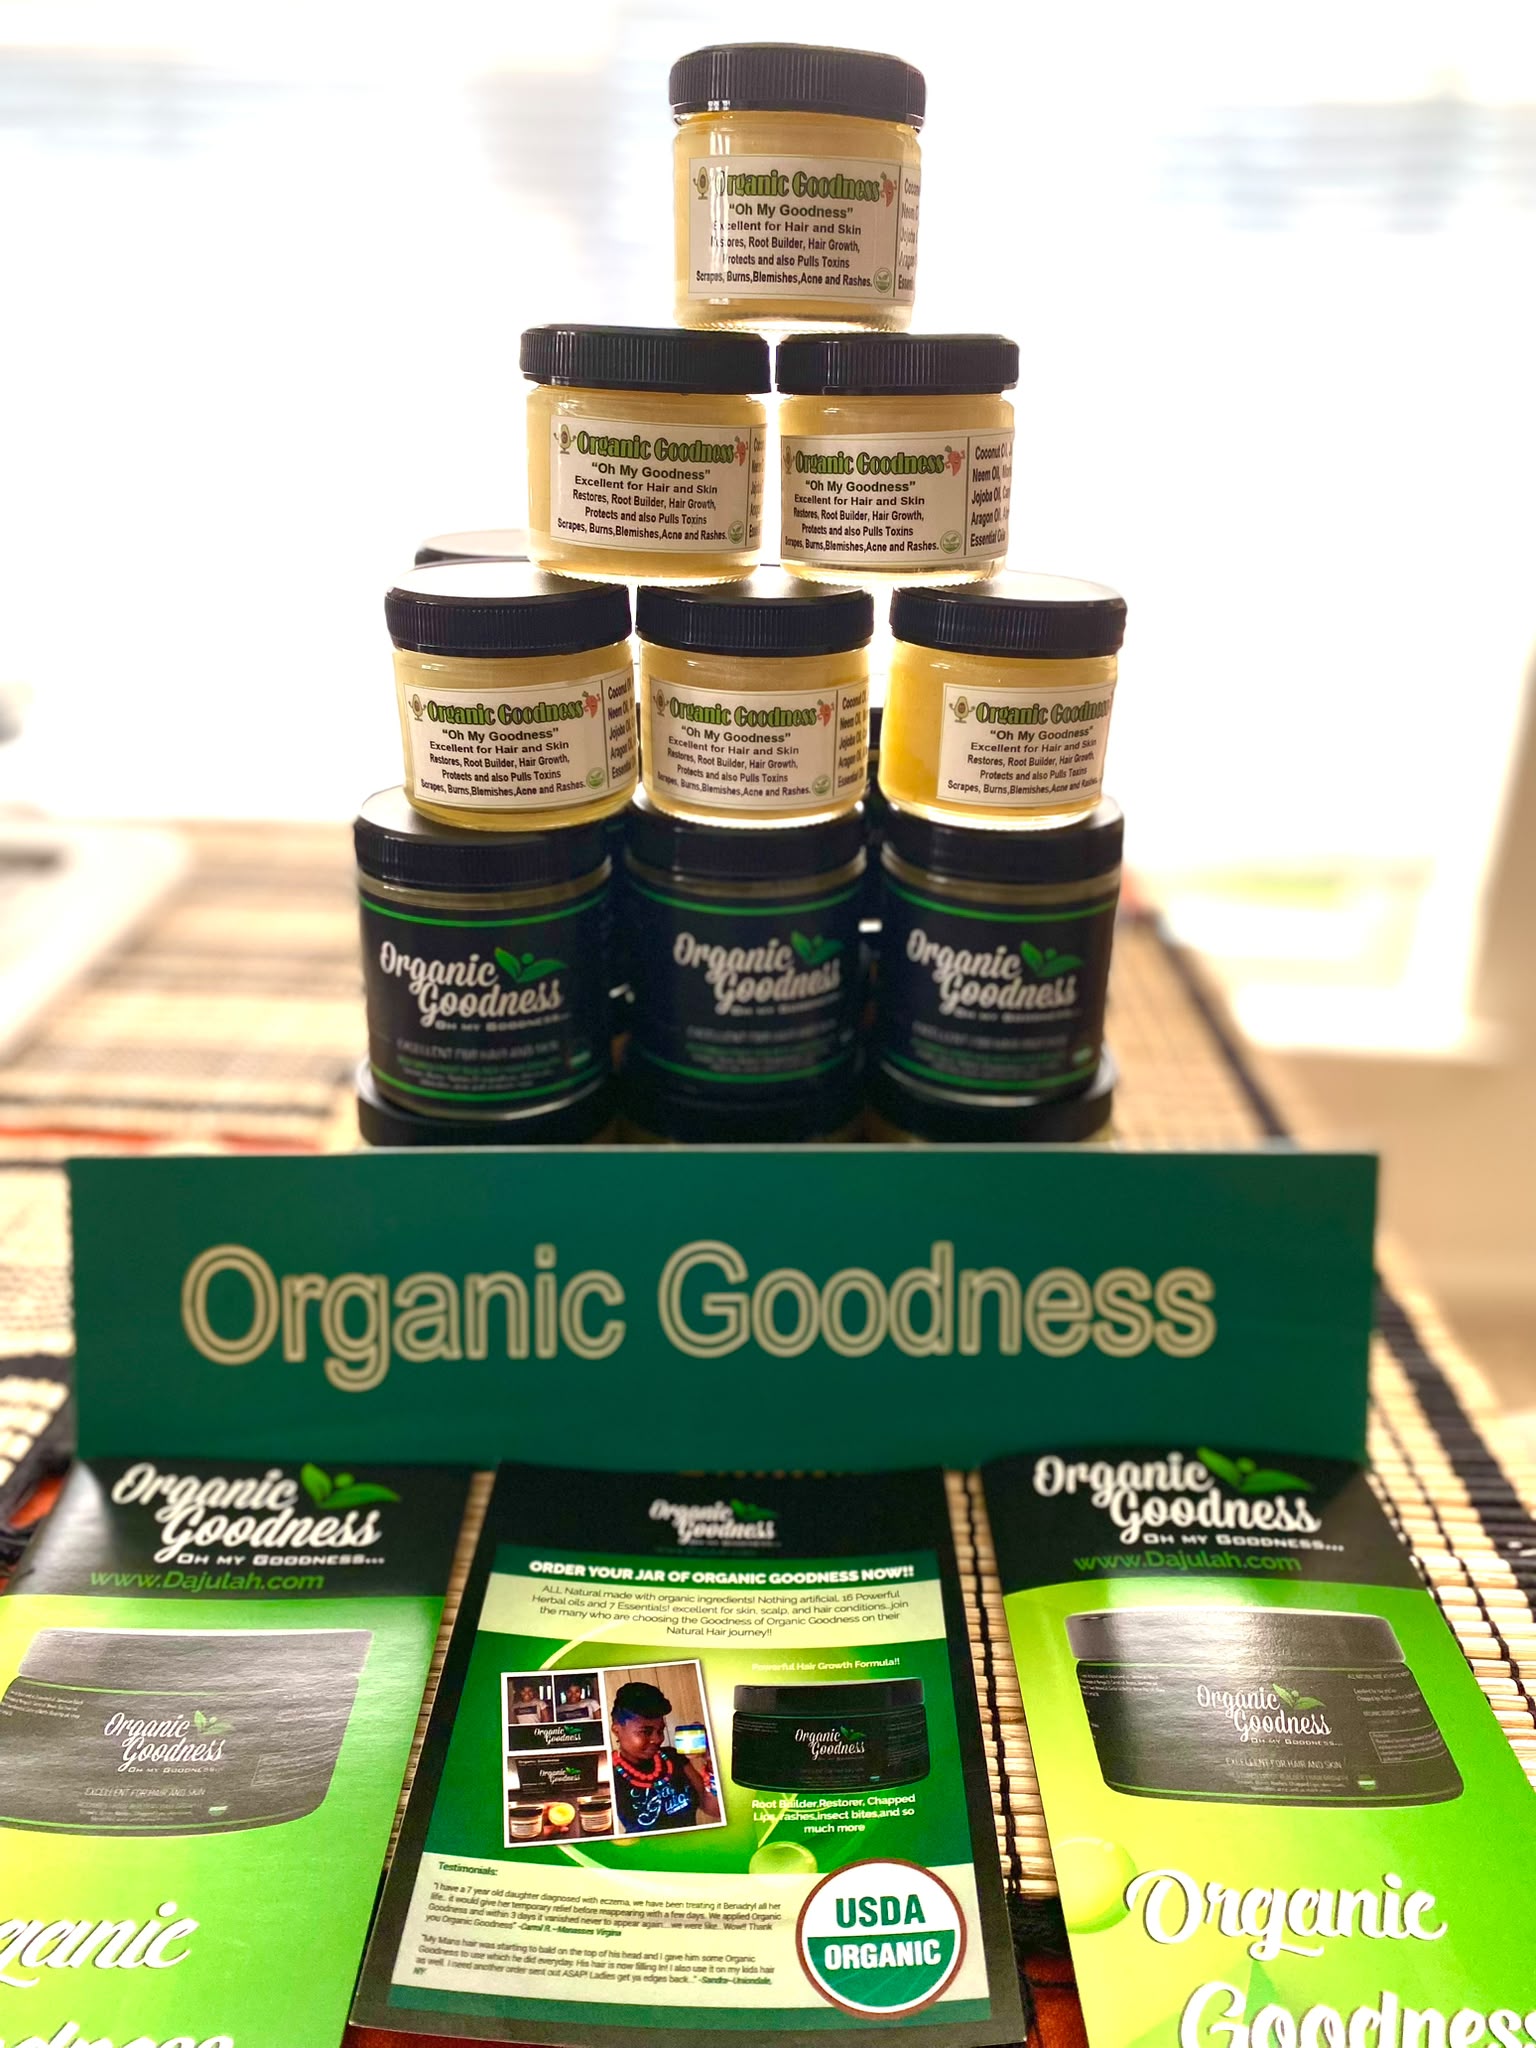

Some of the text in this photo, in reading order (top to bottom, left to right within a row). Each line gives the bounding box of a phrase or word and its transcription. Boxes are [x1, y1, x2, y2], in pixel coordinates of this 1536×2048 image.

[792, 171, 880, 202] Goodness
[576, 430, 734, 463] Organic Goodness
[795, 451, 944, 475] Organic Goodness
[575, 475, 718, 494] Excellent for Hair and Skin
[572, 489, 716, 510] Restores, Root Builder, Hair Growth,
[794, 494, 925, 506] Excellent for Hair and Skin
[585, 506, 707, 525] Protects and also Pulls Toxins
[684, 529, 699, 540] and
[427, 700, 583, 725] Organic Goodness
[670, 697, 817, 727] Organic Goodness
[975, 702, 1048, 725] Organic
[430, 740, 569, 754] Excellent for Hair and Skin
[380, 941, 498, 995] Organic
[673, 932, 794, 984] Organic
[906, 928, 1022, 983] Organic
[714, 958, 840, 1015] Goodness
[939, 974, 1077, 1015] Goodness
[418, 979, 564, 1028] Goodness
[181, 1240, 1218, 1392] Organic Goodness
[1033, 1451, 1215, 1508] Organic
[112, 1463, 299, 1523] Organic
[649, 1499, 734, 1528] Organic
[1110, 1489, 1322, 1544] Goodness
[153, 1506, 382, 1563] Goodness
[677, 1520, 775, 1545] Goodness
[529, 1560, 915, 1584] ORDER YOUR JAR OF ORGANIC GOODNESS NOW!!
[1073, 1549, 1302, 1573] www.Dajulah.com
[90, 1570, 325, 1593] www.Dajulah.com
[532, 1594, 568, 1606] Herbal
[569, 1597, 585, 1608] oils
[587, 1598, 607, 1609] and
[609, 1601, 616, 1610] 7
[672, 1603, 718, 1614] excellent
[720, 1605, 734, 1614] for
[792, 1604, 811, 1614] and
[813, 1602, 831, 1613] hair
[542, 1584, 561, 1594] ALL
[564, 1586, 601, 1598] Natural
[603, 1590, 632, 1600] made
[635, 1591, 656, 1601] with
[658, 1592, 695, 1605] organic
[758, 1594, 798, 1605] Nothing
[842, 1592, 853, 1601] 16
[856, 1589, 901, 1601] Powerful
[540, 1605, 900, 1627] the many who are choosing the Goodness of Organic Goodness on their
[666, 1625, 704, 1636] Natural
[706, 1627, 726, 1637] Hair
[752, 1662, 795, 1672] Powerful
[797, 1662, 816, 1671] Hair
[817, 1661, 853, 1671] Growth
[1196, 1683, 1280, 1720] Organic
[104, 1712, 191, 1748] Organic
[795, 1728, 840, 1745] Organic
[1234, 1709, 1332, 1742] Goodness
[117, 1739, 225, 1772] Goodness
[809, 1740, 865, 1760] Goodness
[751, 1800, 777, 1809] Root
[867, 1794, 916, 1806] Chapped
[902, 1808, 915, 1816] so
[804, 1824, 865, 1834] much more
[438, 1861, 499, 1876] Testimonials:
[836, 1894, 926, 1928] USDA
[1122, 1869, 1448, 1961] Organic
[824, 1939, 941, 1970] ORGANIC
